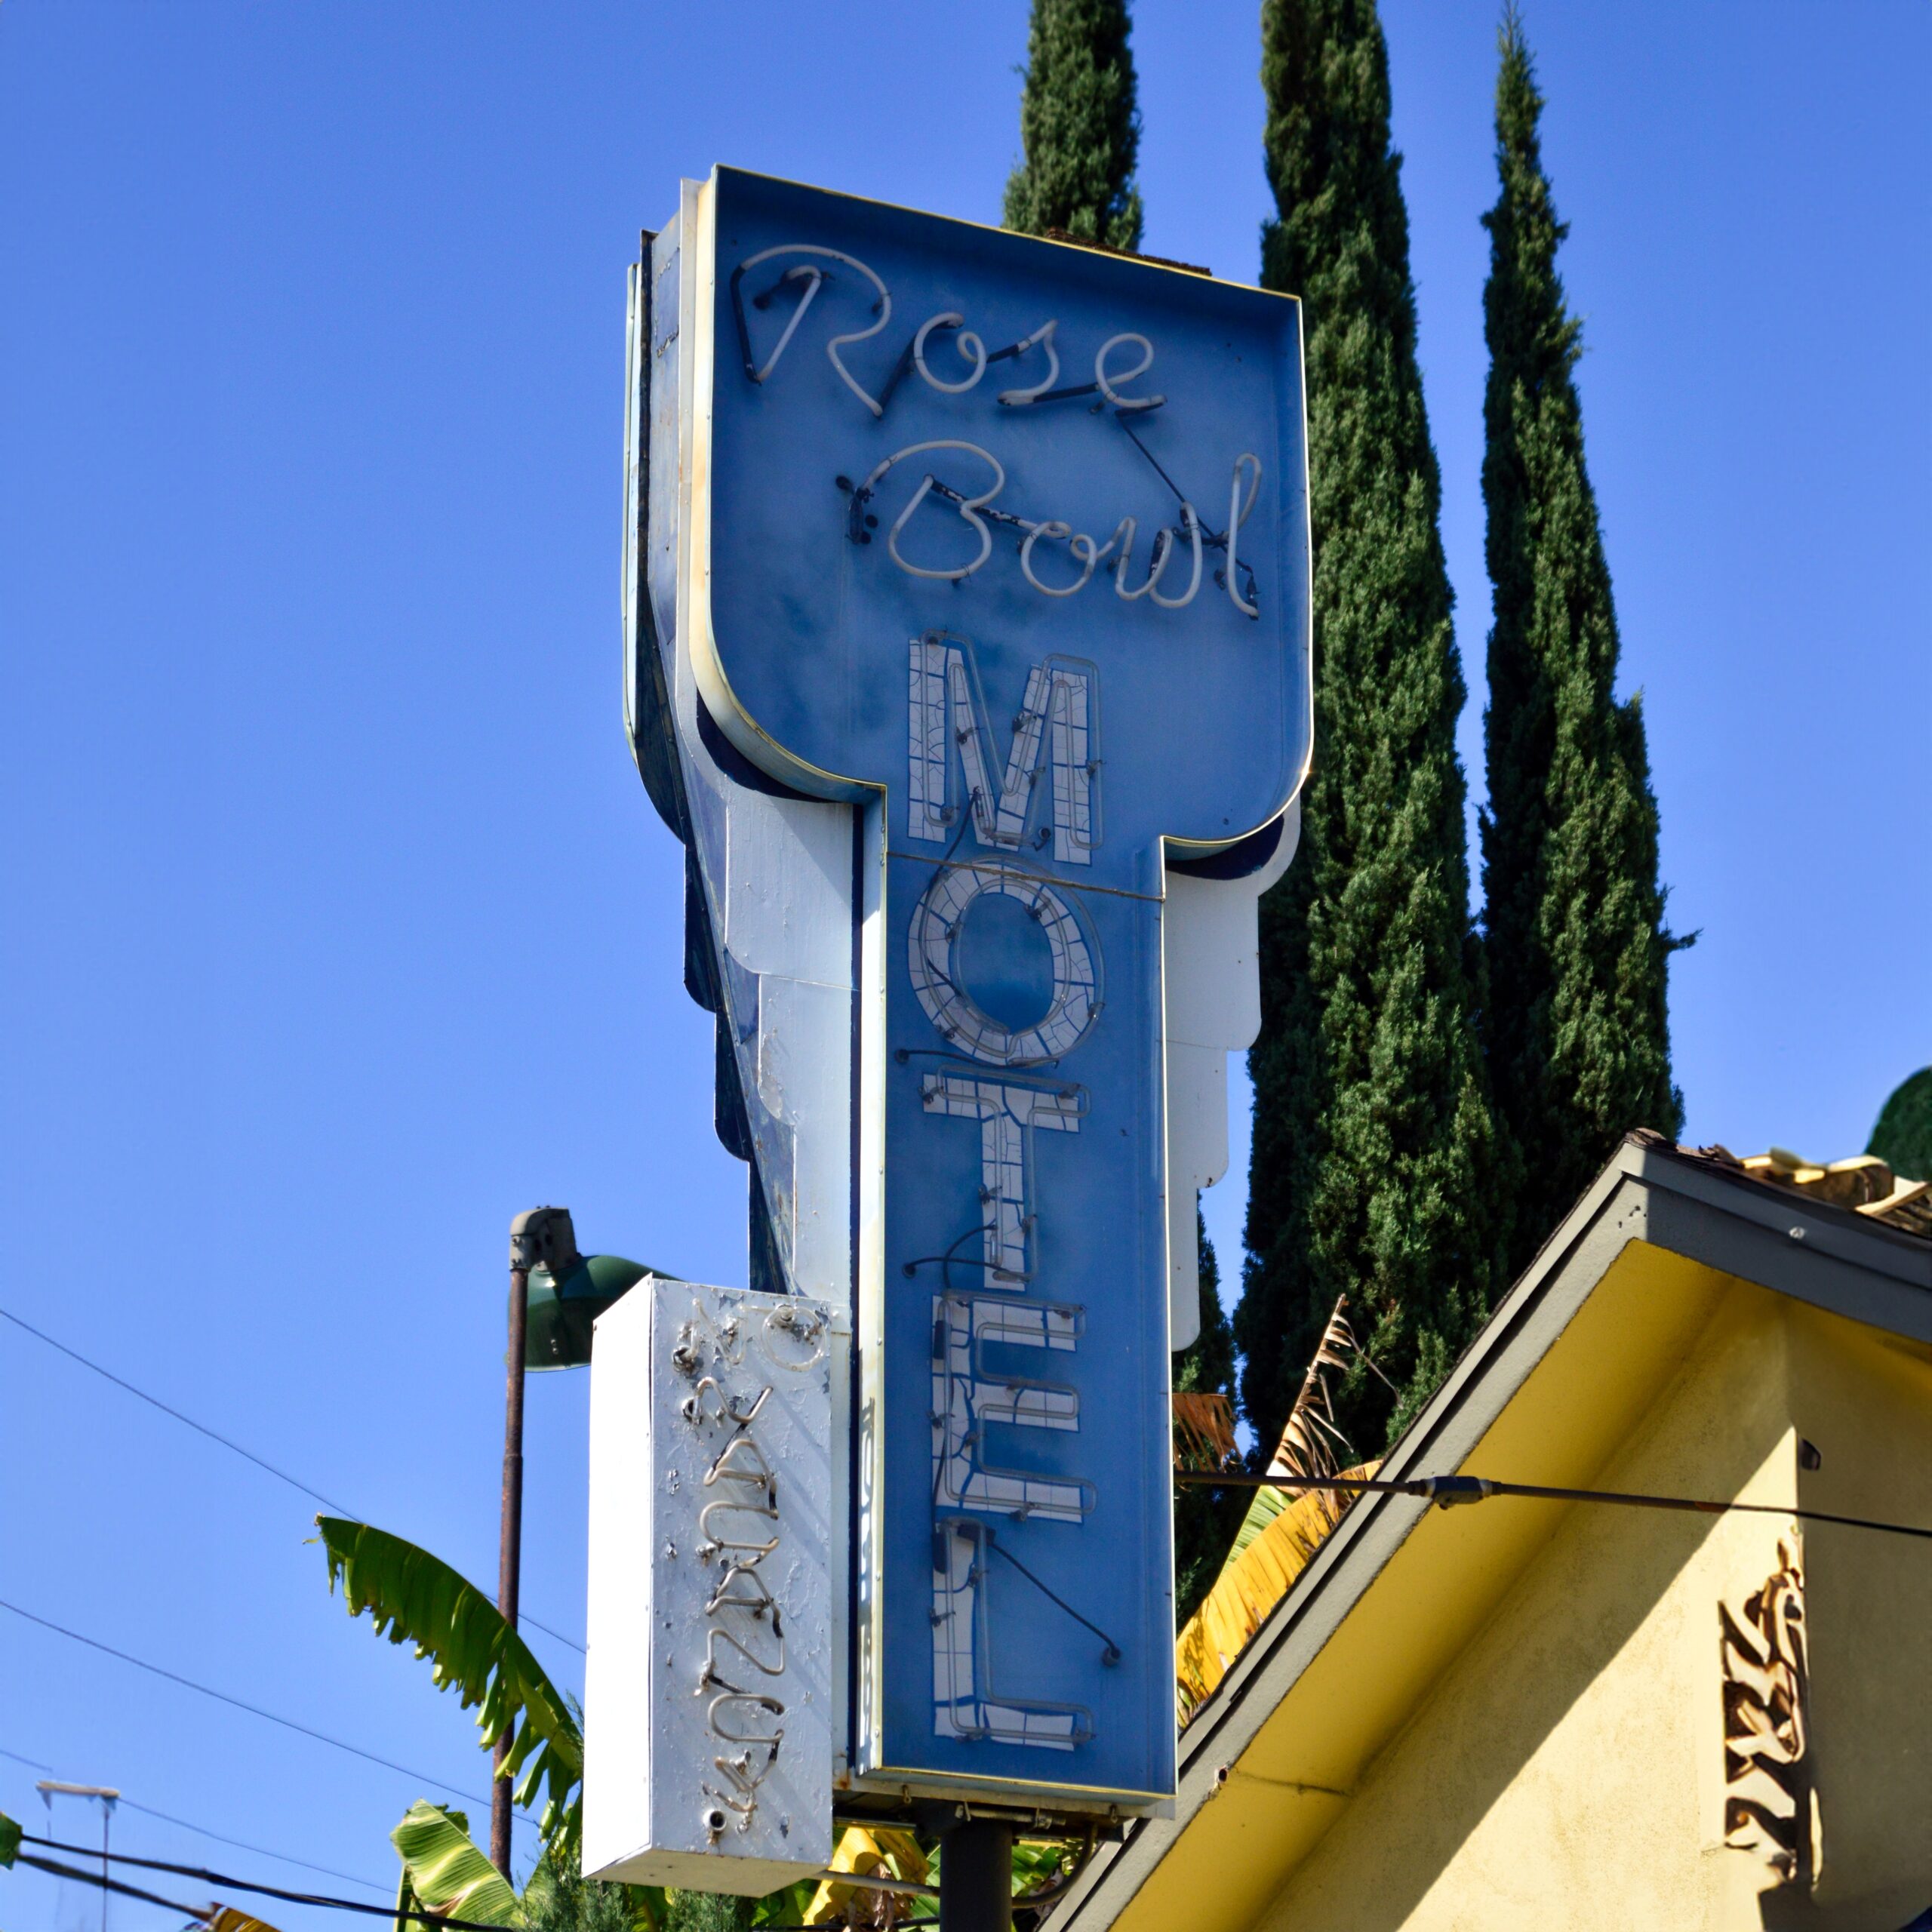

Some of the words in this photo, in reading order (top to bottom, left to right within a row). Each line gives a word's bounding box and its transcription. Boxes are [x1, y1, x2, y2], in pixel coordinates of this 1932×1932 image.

[730, 243, 1167, 417] Rose
[862, 439, 1259, 620] Bowl
[908, 629, 1103, 1751] MOTEL
[685, 1298, 828, 1372] NO
[693, 1376, 786, 1812] VACANCY
